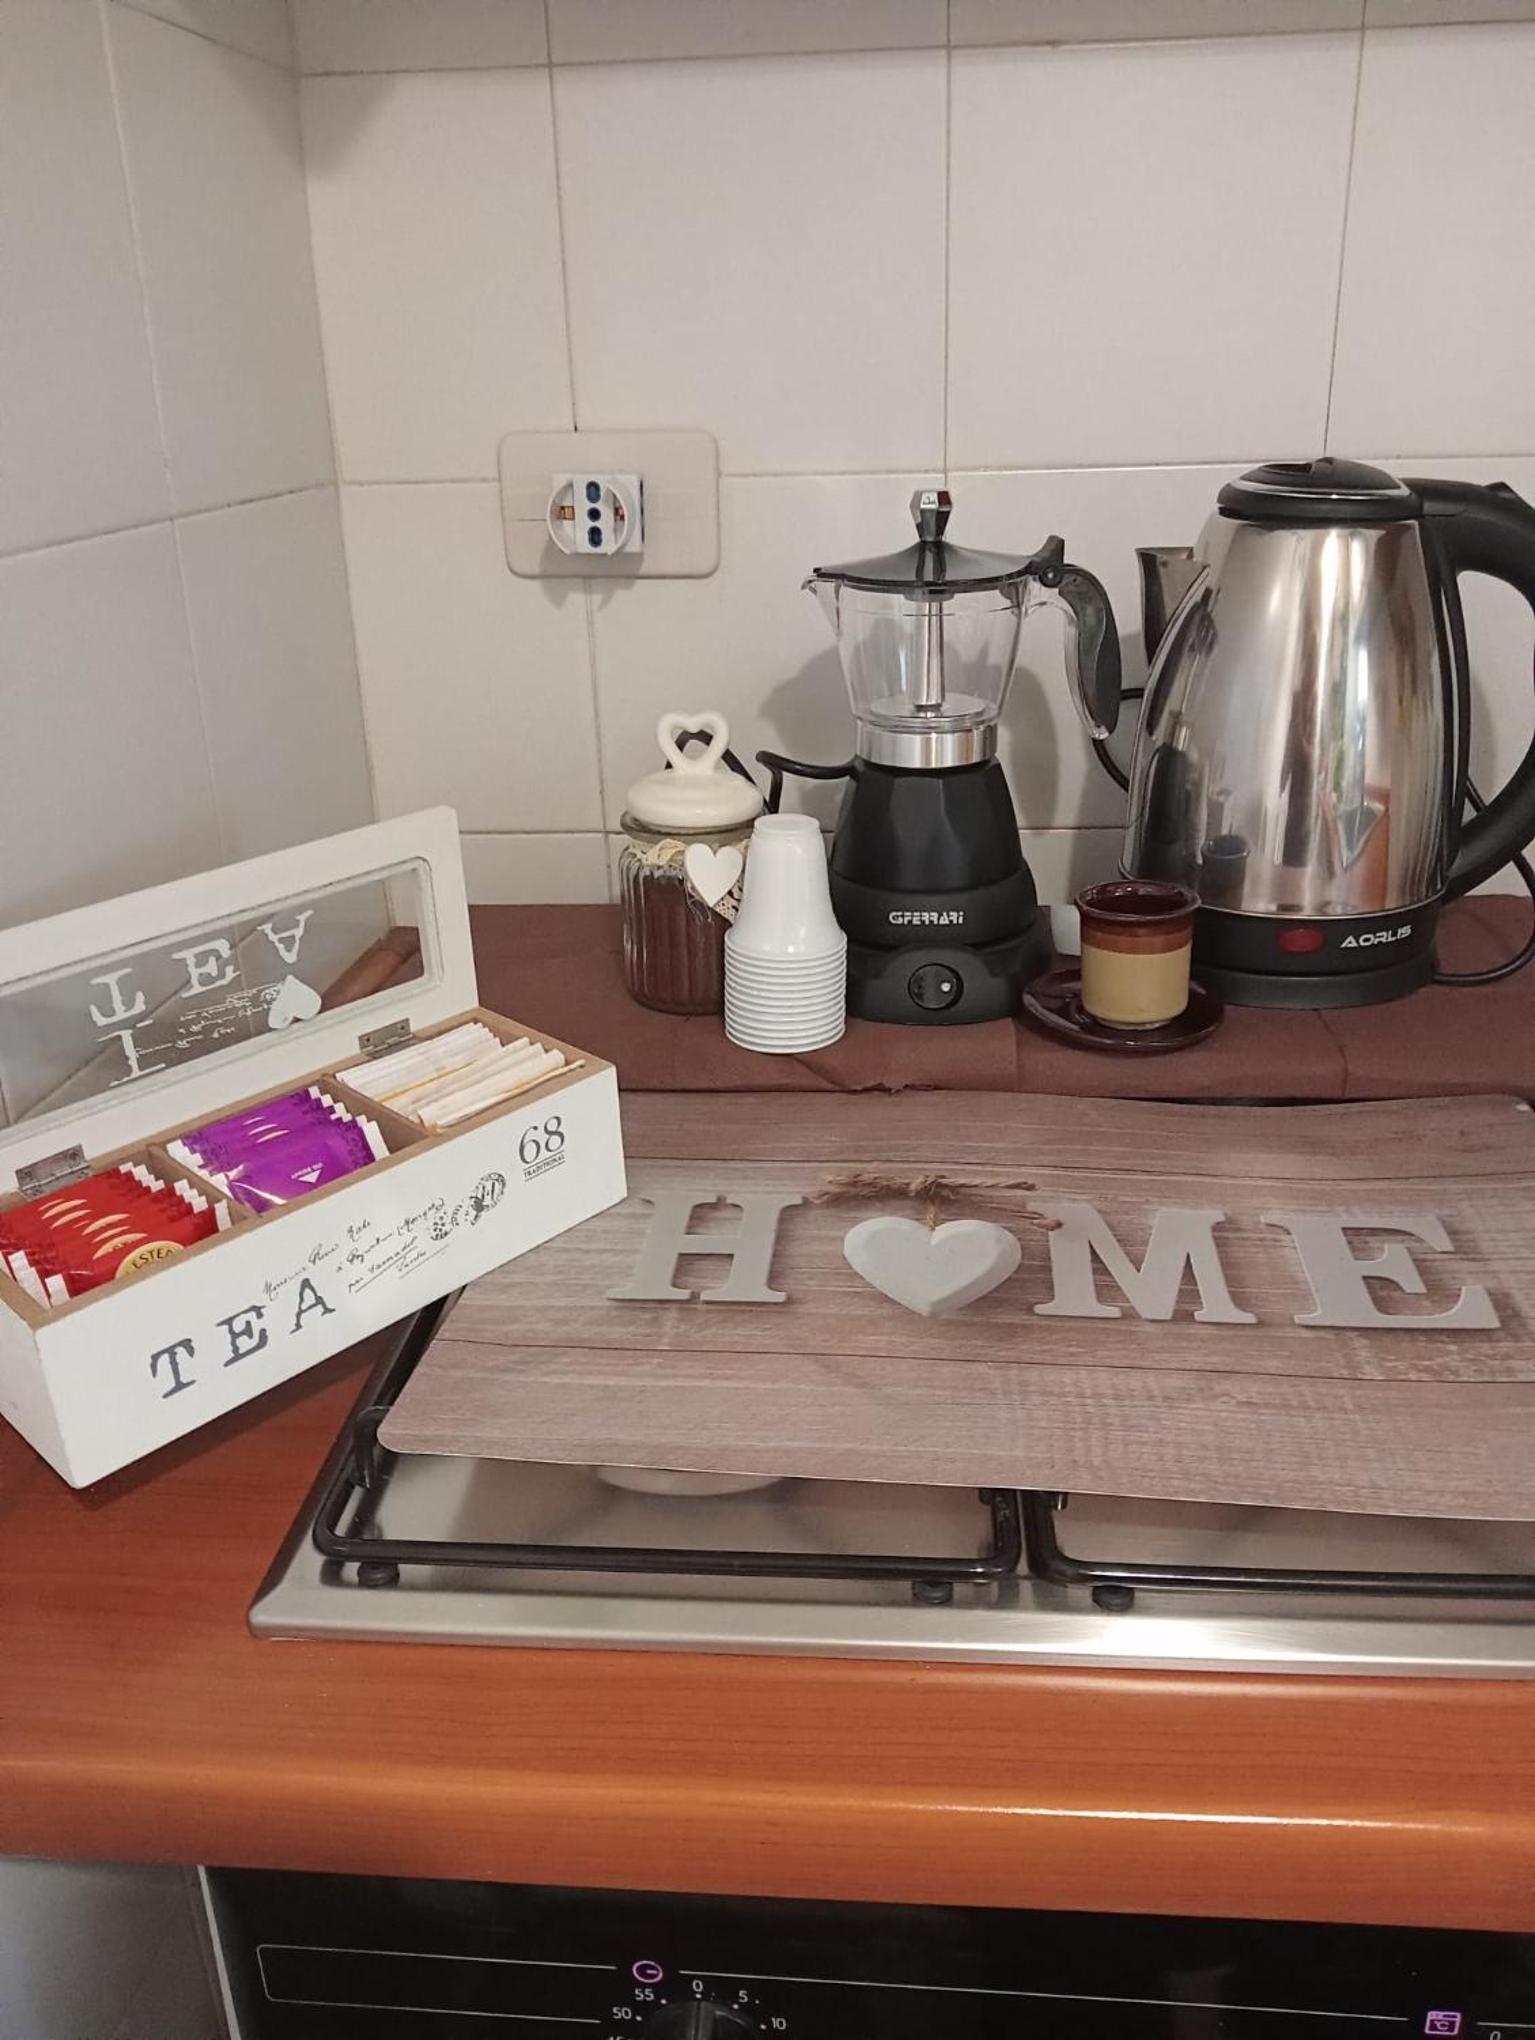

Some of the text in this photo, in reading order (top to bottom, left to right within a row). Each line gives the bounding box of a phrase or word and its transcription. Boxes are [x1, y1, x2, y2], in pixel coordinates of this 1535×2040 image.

[518, 1115, 565, 1165] 68
[149, 1276, 337, 1399] TEA
[692, 1980, 703, 1993] 0
[634, 1988, 655, 2001] 55
[738, 1990, 749, 2003] 5
[612, 2006, 632, 2020] 50
[771, 2016, 787, 2030] 10
